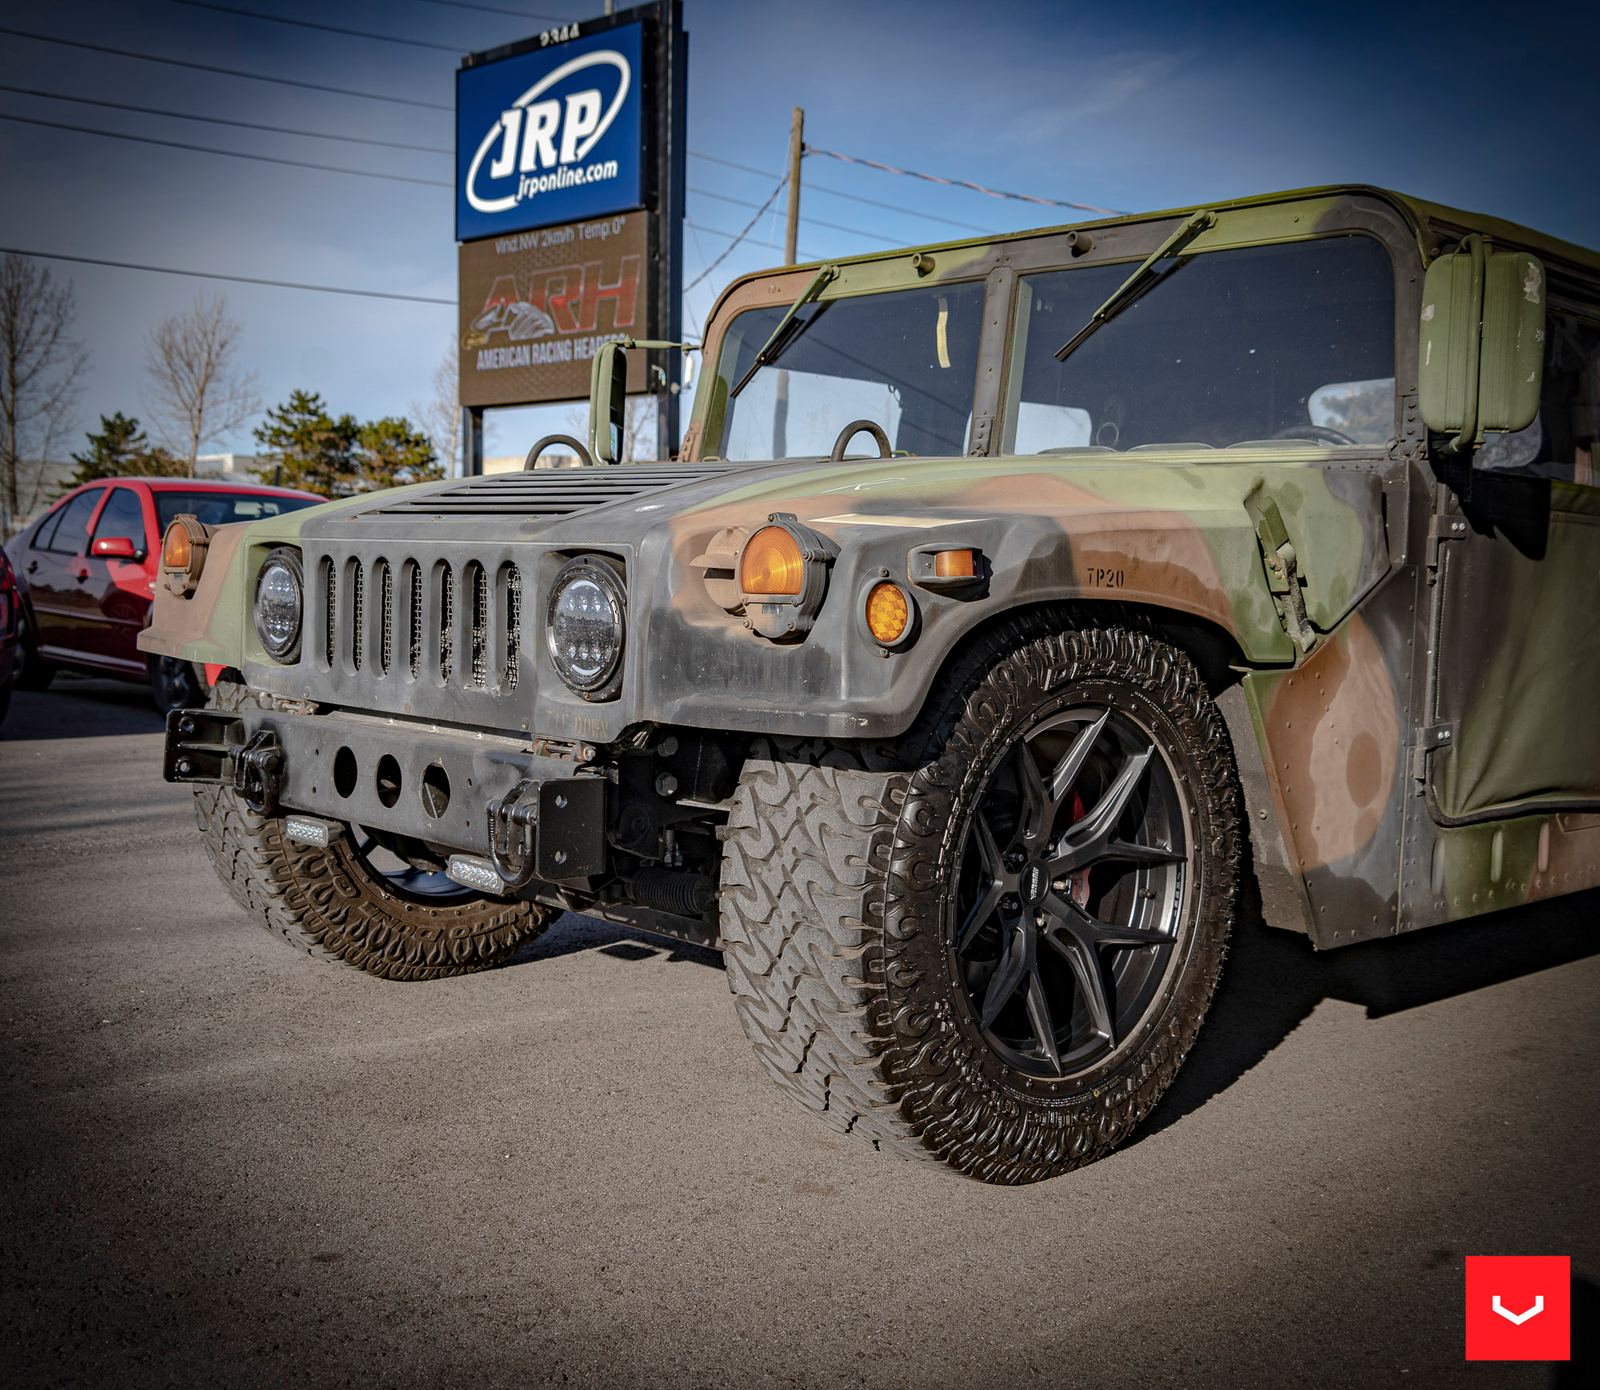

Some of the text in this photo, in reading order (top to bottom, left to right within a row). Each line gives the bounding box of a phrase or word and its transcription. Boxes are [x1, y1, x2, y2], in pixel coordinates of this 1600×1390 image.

[540, 23, 580, 46] 9344
[490, 89, 602, 180] JRP
[517, 160, 618, 200] jrponline.com
[466, 254, 642, 341] ARH
[476, 344, 531, 371] AMERICAN
[531, 339, 572, 365] RACING
[1087, 567, 1125, 588] TP20
